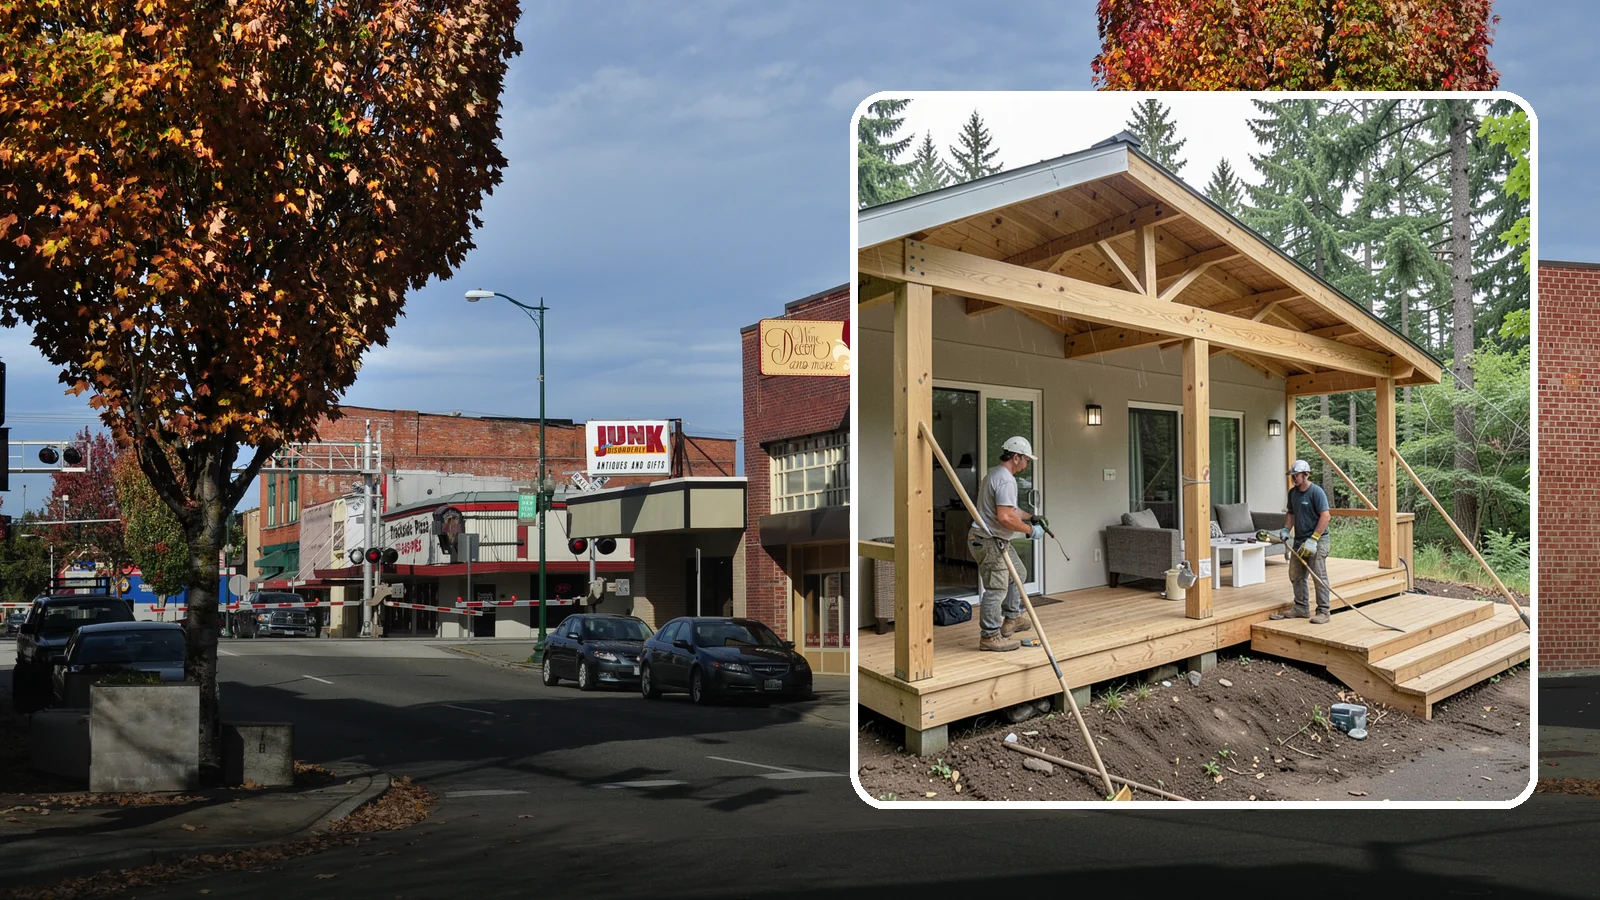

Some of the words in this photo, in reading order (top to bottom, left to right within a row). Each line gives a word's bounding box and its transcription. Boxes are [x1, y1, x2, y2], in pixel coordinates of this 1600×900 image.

[765, 328, 831, 365] Decor
[595, 425, 665, 457] JUNK
[608, 446, 646, 454] DISORDERLY
[597, 461, 628, 470] ANTIQUES
[631, 461, 644, 470] AND
[647, 460, 665, 470] GIFTS
[415, 519, 429, 535] Pizza
